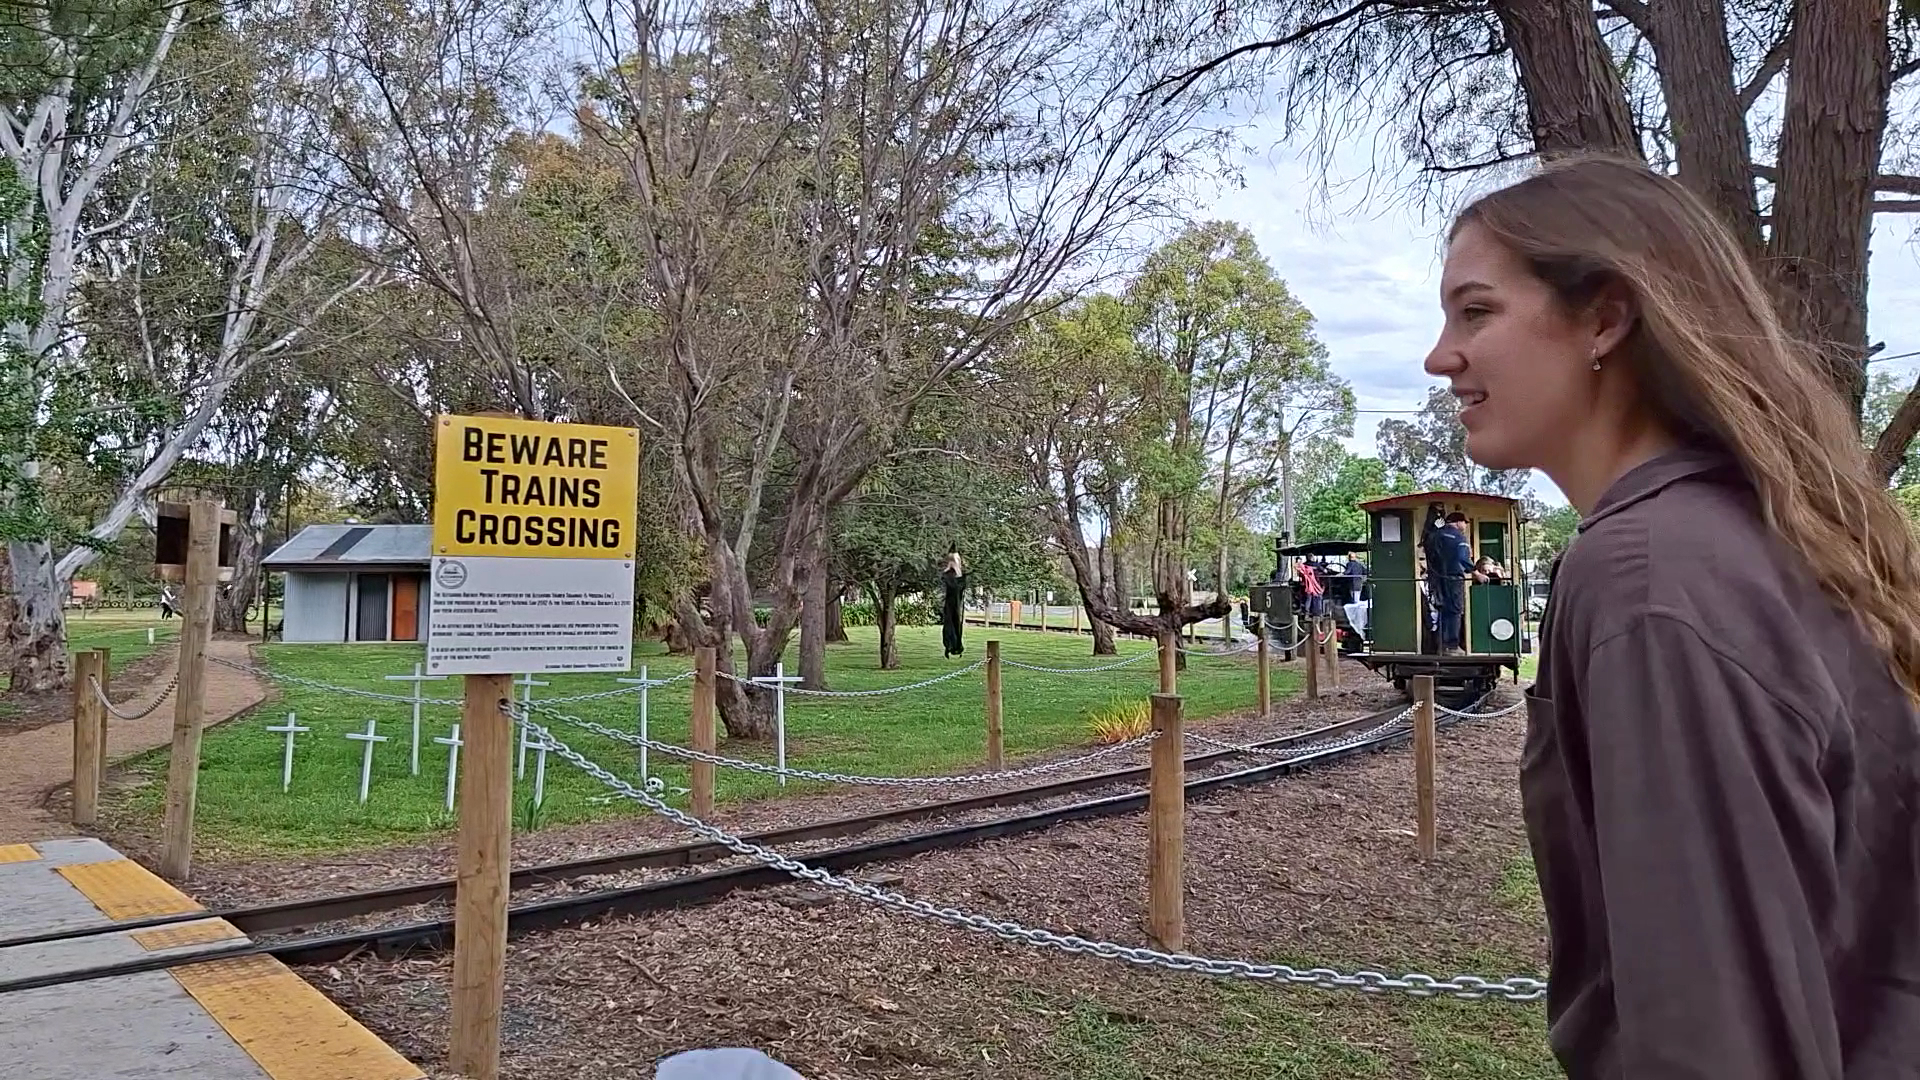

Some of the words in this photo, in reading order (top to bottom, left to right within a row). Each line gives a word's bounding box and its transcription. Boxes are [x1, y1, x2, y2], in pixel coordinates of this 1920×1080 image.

[463, 426, 608, 469] BEWARE
[480, 468, 601, 508] TRAINS
[456, 509, 620, 548] CROSSING
[1265, 591, 1272, 609] 5
